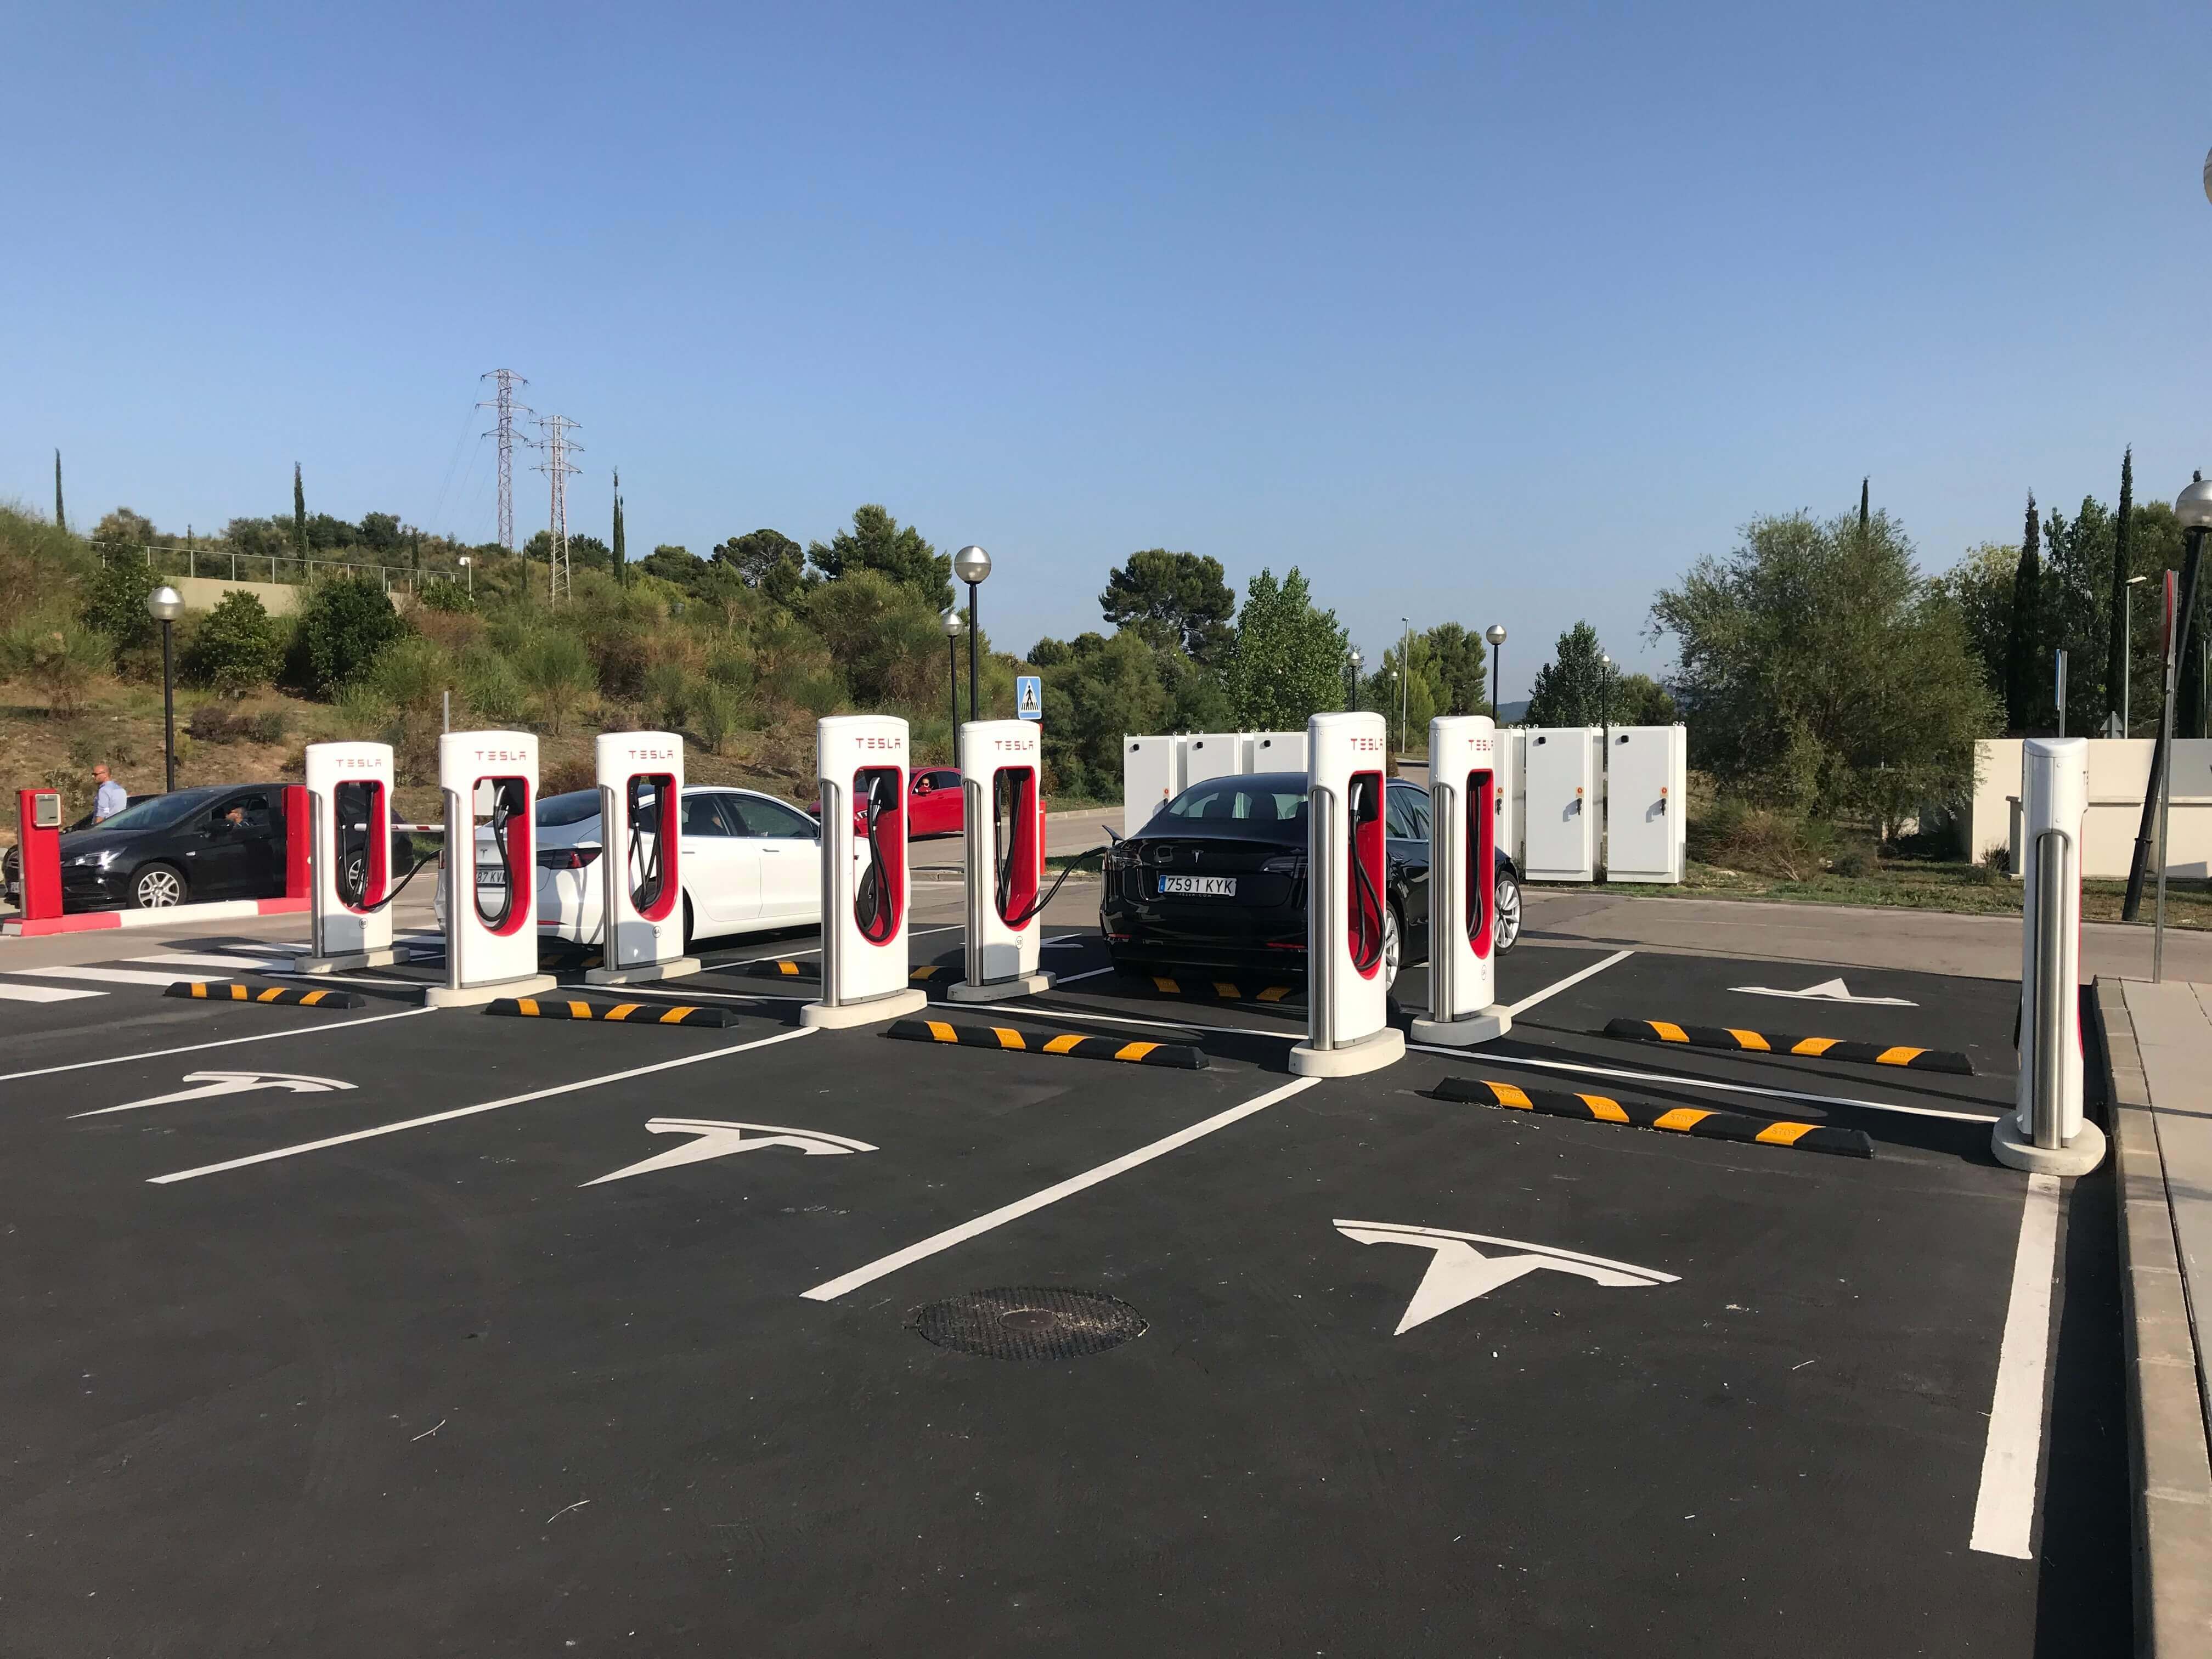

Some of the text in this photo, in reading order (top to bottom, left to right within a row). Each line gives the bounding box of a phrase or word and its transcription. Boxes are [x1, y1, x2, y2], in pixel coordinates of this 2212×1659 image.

[855, 738, 901, 749] TESLA
[995, 741, 1034, 751] TESLA
[1351, 738, 1384, 751] TESLA
[475, 751, 526, 761] TESLA
[628, 750, 673, 760] TESLA
[336, 759, 382, 768] TESLA
[1167, 878, 1233, 894] 7591 KYK
[1498, 1088, 1522, 1099] STOP
[1593, 1102, 1618, 1113] STOP
[1669, 1113, 1694, 1124] STOP
[1771, 1126, 1797, 1137] STOP
